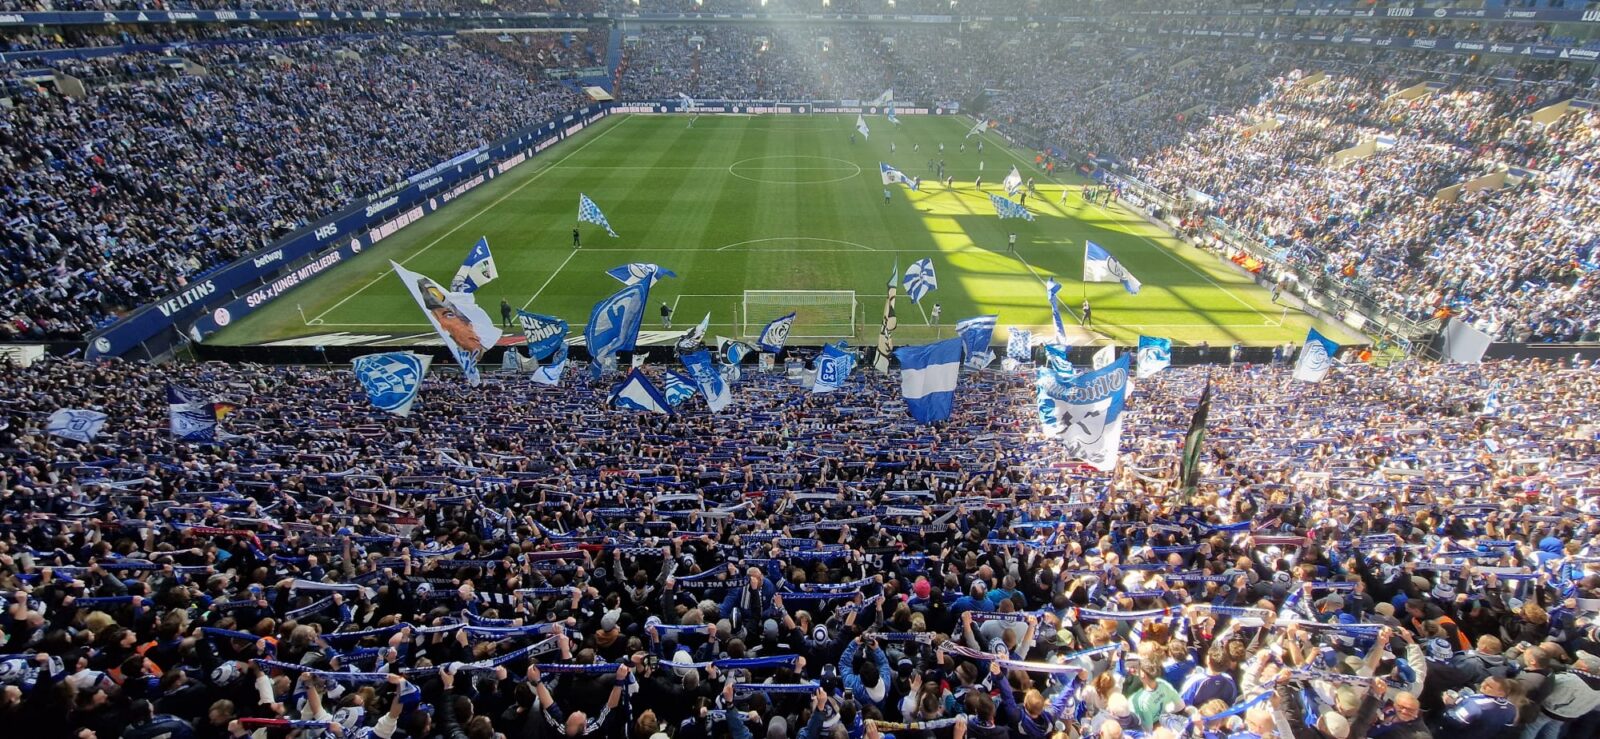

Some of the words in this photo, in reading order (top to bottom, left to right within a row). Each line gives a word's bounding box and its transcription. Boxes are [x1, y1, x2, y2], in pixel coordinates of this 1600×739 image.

[314, 222, 338, 241] HRS
[253, 249, 283, 268] betway
[272, 272, 299, 296] JUNGE
[299, 250, 341, 281] MITGLIEDER
[157, 279, 216, 318] VELTINS
